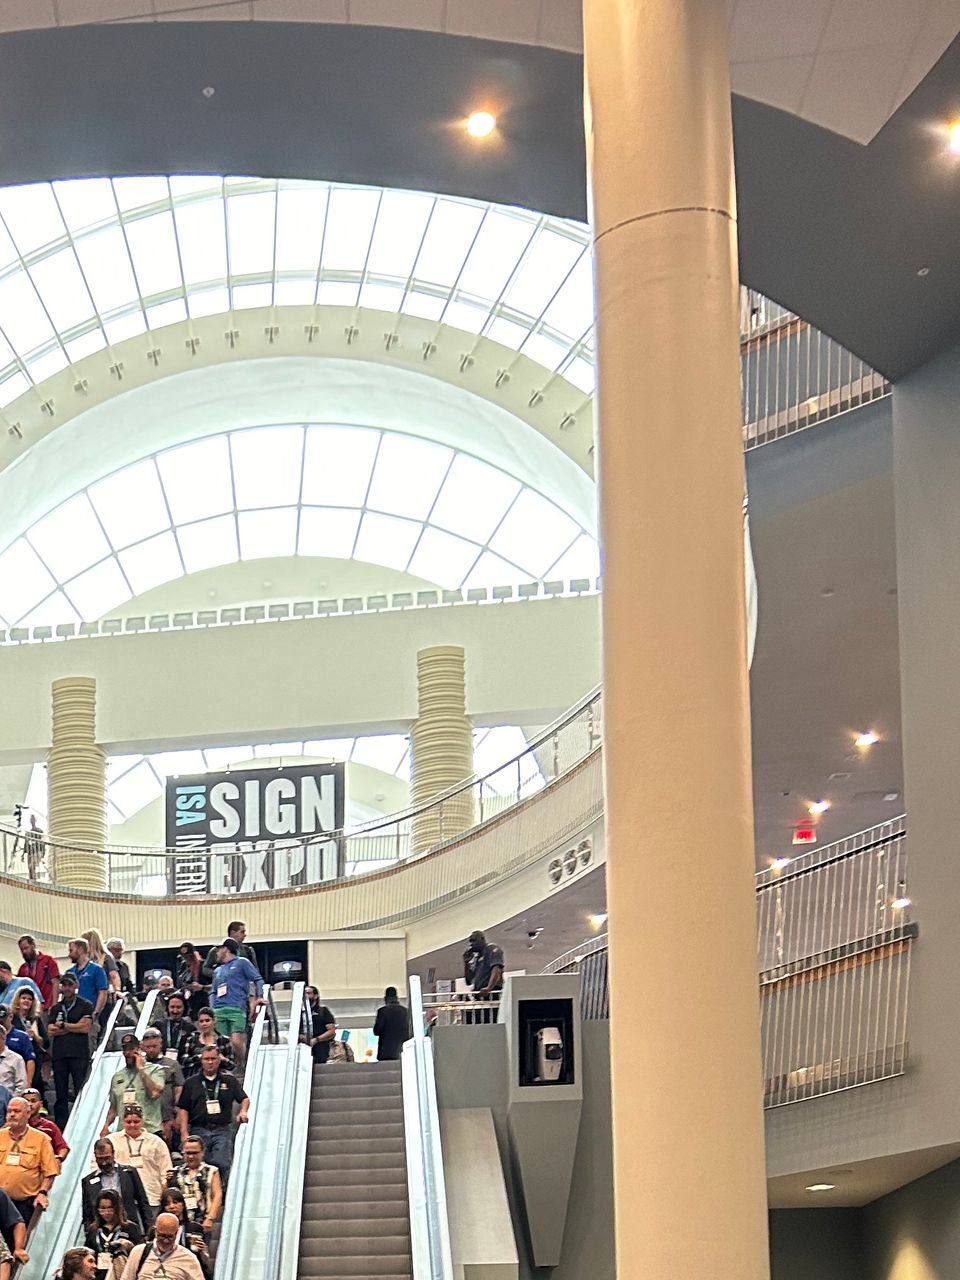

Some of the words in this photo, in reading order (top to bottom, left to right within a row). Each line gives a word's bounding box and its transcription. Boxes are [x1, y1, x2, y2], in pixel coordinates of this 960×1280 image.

[175, 785, 207, 827] ISA
[209, 774, 335, 838] SIGN
[209, 836, 339, 894] EXPO
